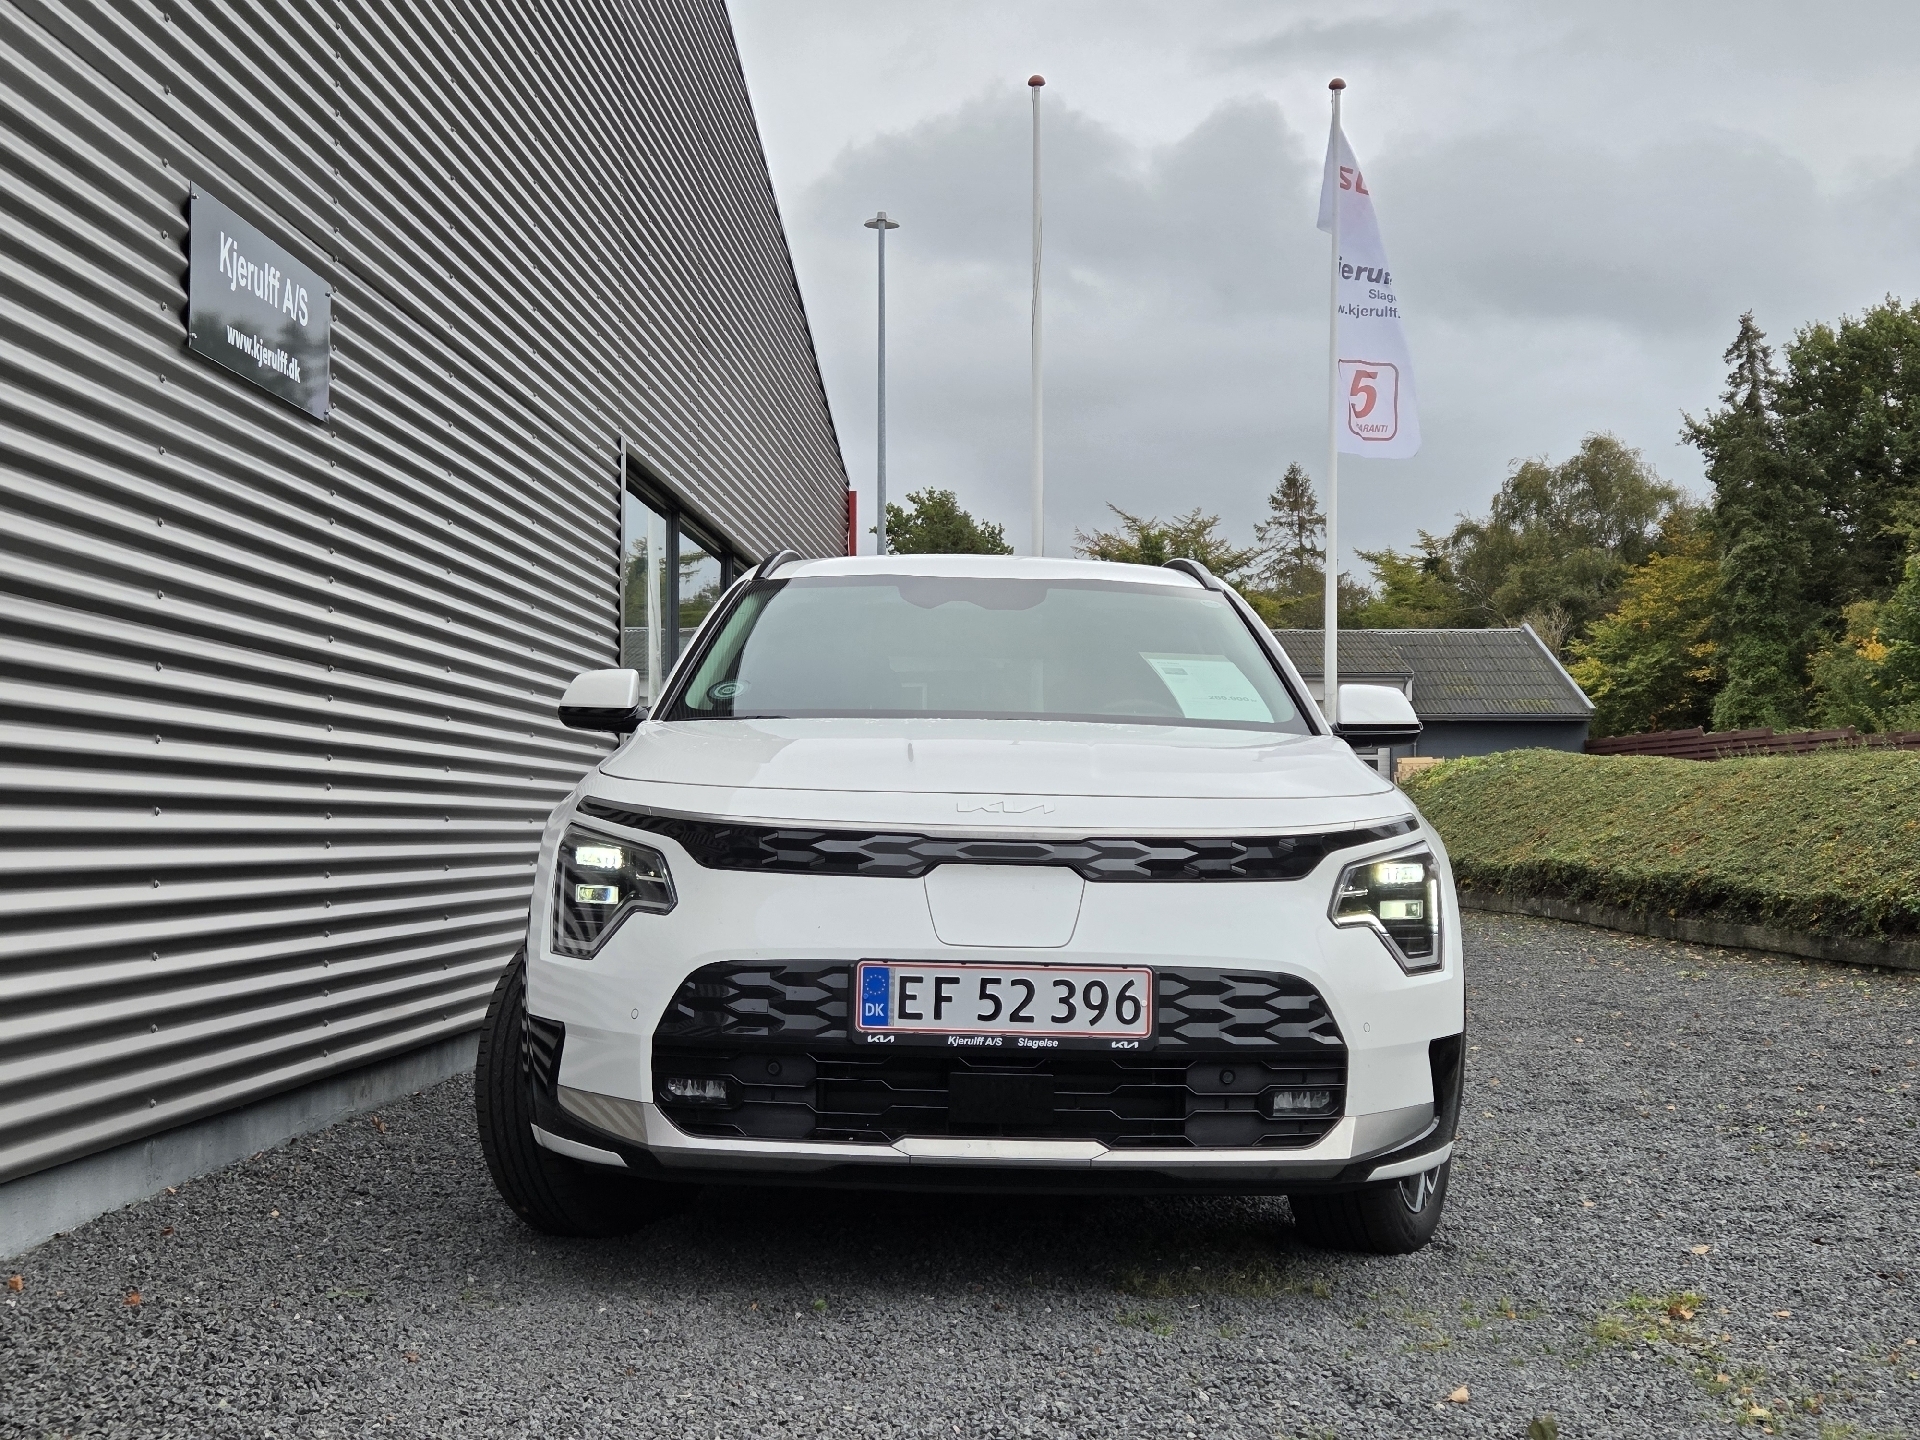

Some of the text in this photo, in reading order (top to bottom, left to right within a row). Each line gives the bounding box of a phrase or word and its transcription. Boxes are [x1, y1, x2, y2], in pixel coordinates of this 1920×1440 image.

[220, 231, 309, 327] Kjerulff A/S
[226, 324, 301, 384] www.kjerulff.dk
[1350, 369, 1378, 418] 5
[1355, 422, 1388, 433] ARANTI
[865, 1002, 885, 1017] DK
[898, 975, 1142, 1026] EF 52 396
[947, 1035, 1003, 1047] Kjerulff A/S
[1017, 1037, 1059, 1049] Slagelse
